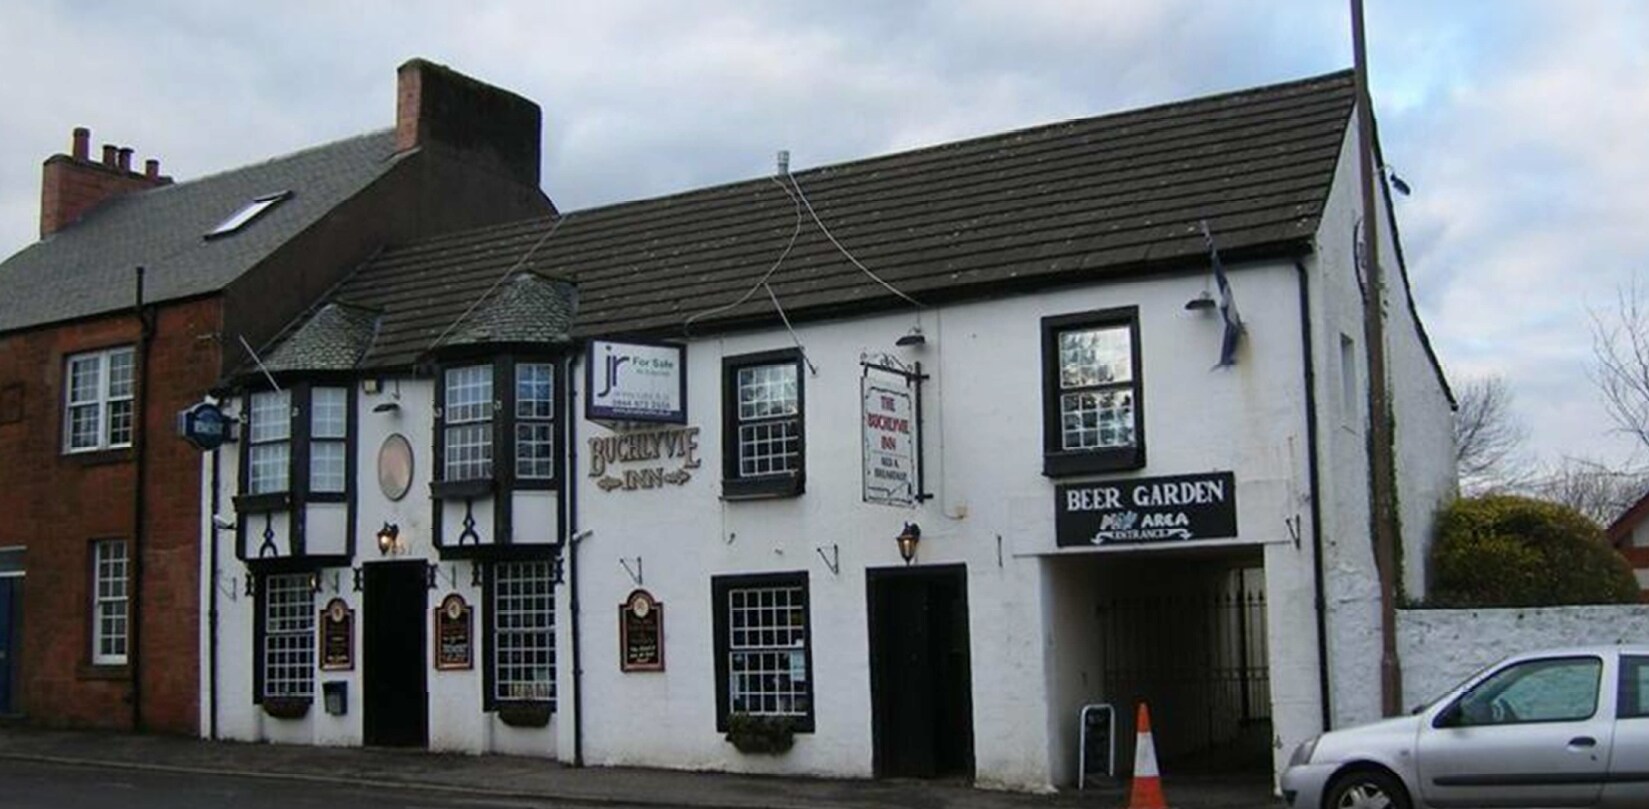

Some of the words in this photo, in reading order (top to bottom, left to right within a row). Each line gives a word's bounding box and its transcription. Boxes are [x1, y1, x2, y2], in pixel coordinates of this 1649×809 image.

[597, 345, 630, 398] jr
[632, 357, 649, 366] For
[652, 358, 673, 368] Sale
[881, 396, 895, 411] THE
[868, 413, 909, 434] BUCHLYVIE
[881, 436, 896, 449] INN
[588, 427, 702, 478] BUCHLYVIE
[622, 467, 664, 491] INN
[1066, 487, 1122, 511] BEER
[1132, 480, 1224, 507] GARDEN
[1140, 512, 1190, 529] AREA
[1114, 528, 1168, 541] ENTRANCE
